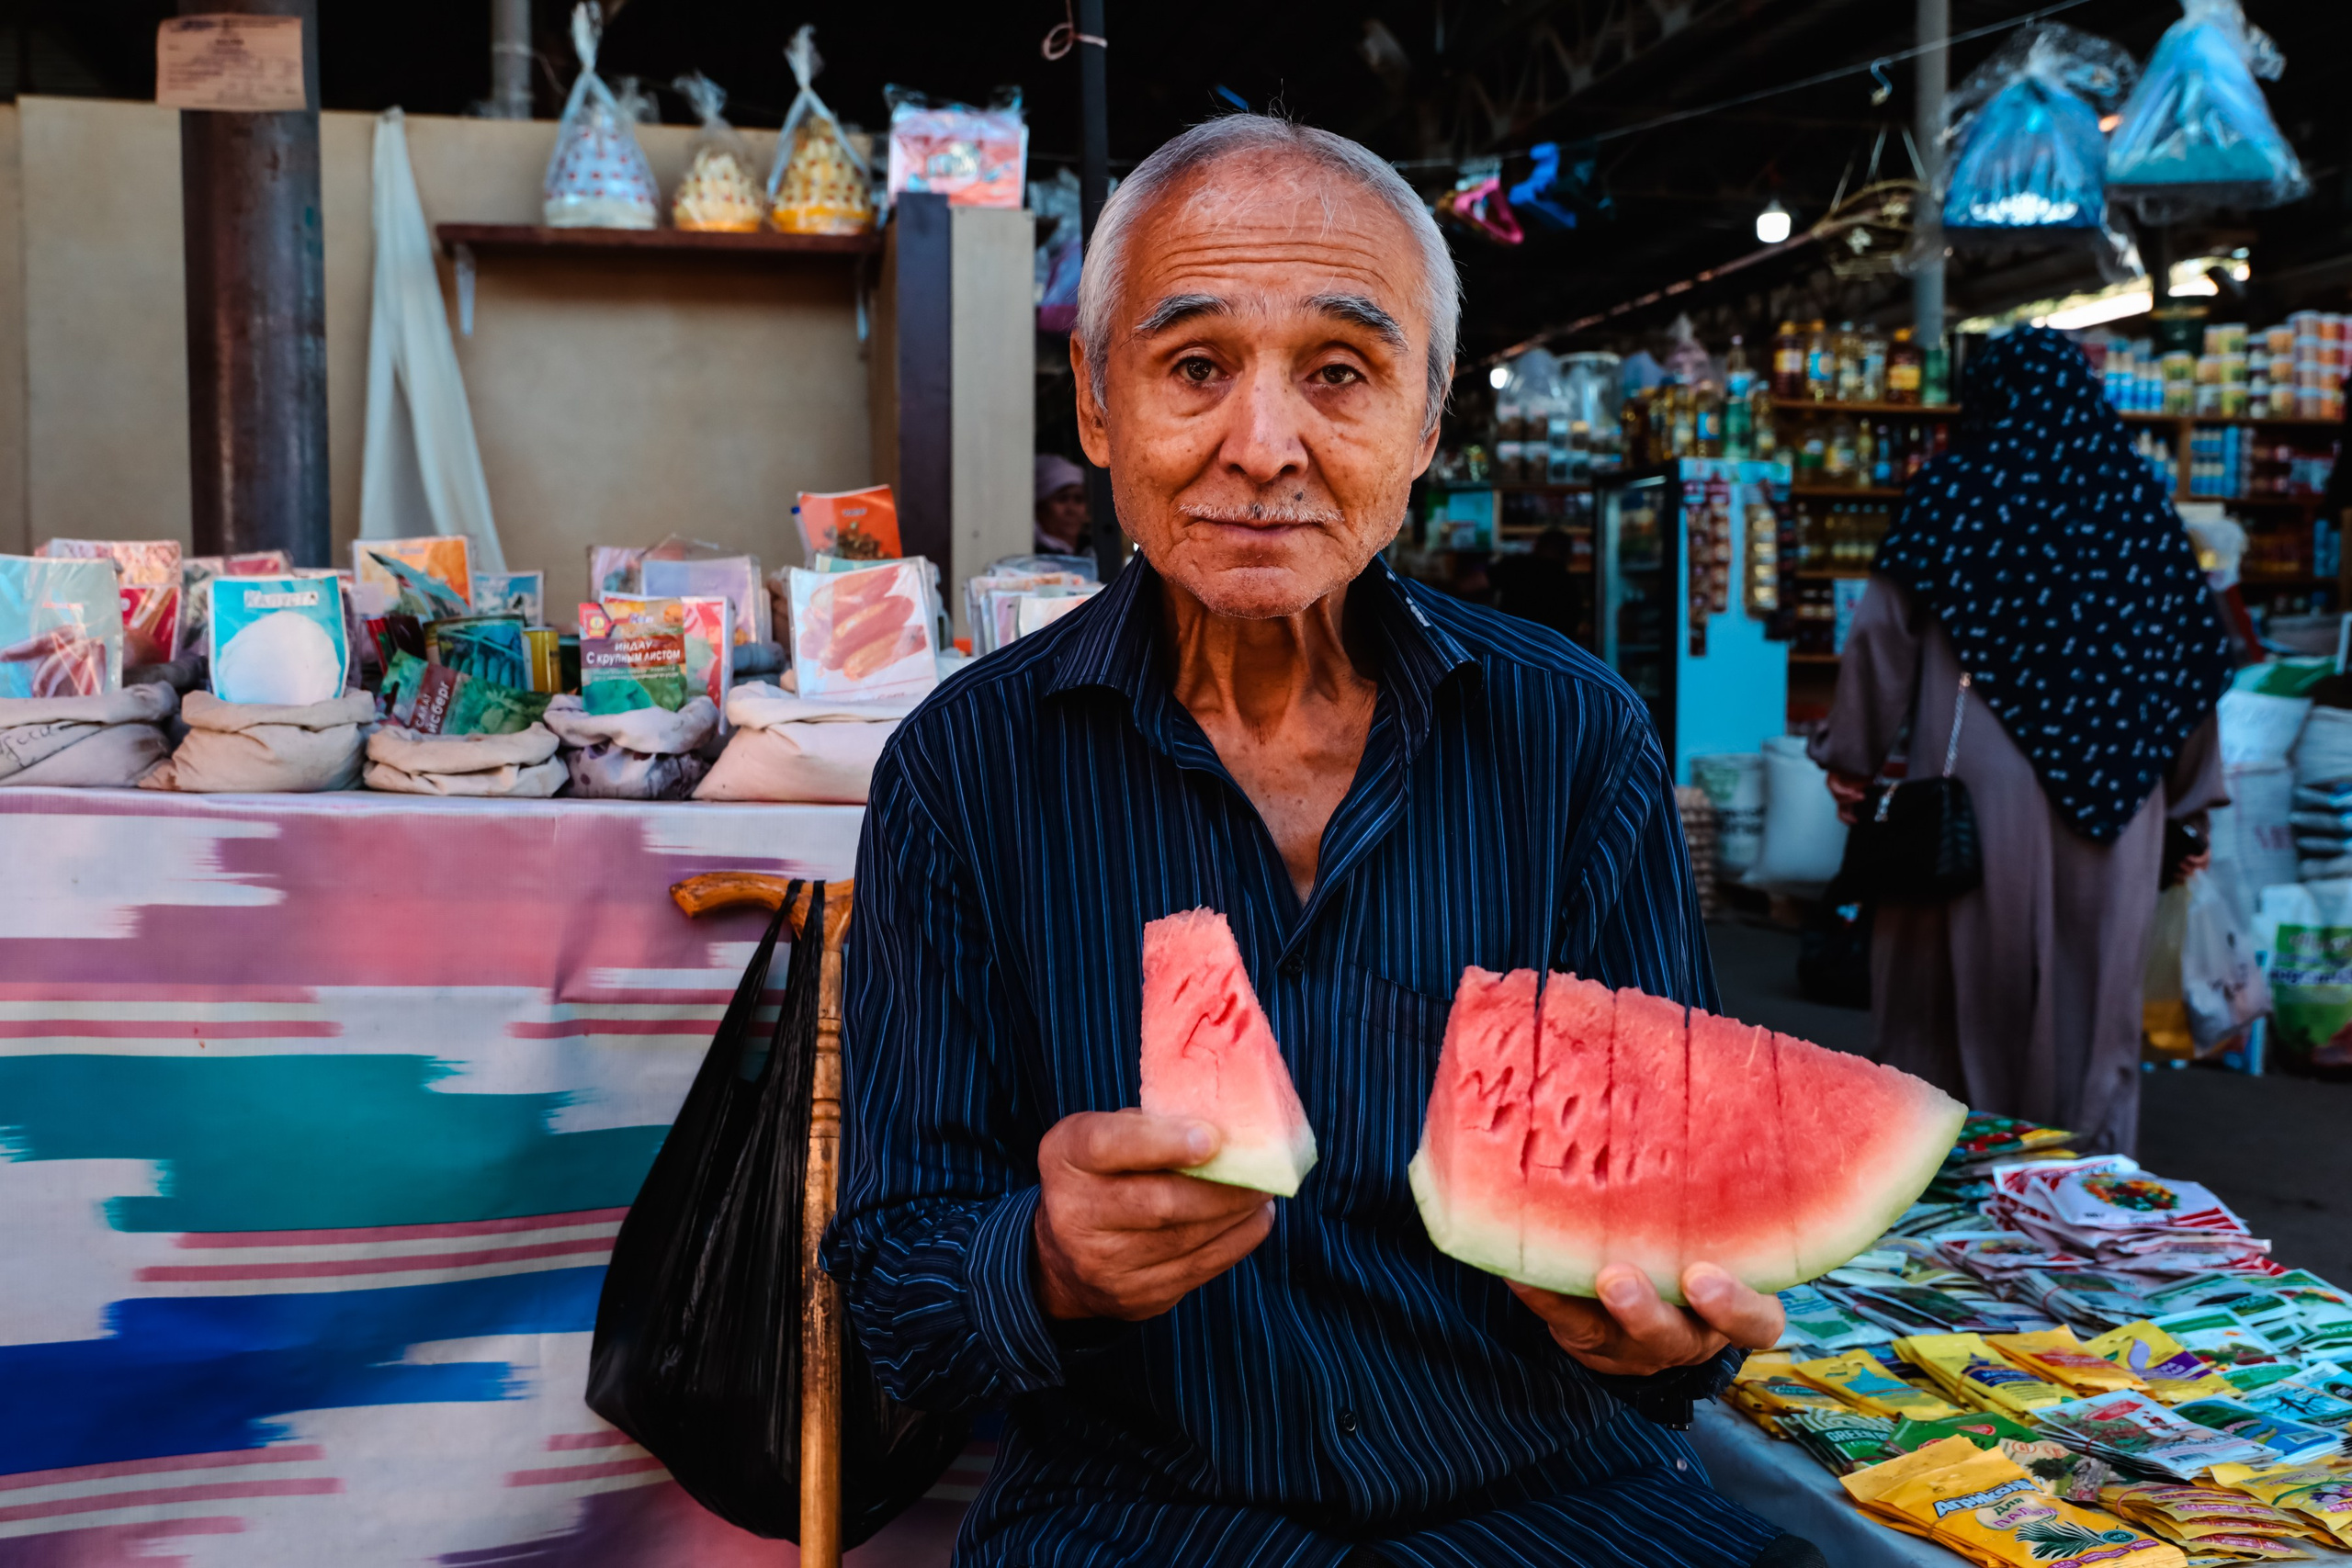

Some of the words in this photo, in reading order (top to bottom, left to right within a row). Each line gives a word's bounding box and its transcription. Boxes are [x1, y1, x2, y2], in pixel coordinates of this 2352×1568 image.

[615, 640, 653, 652] ИНДАУ
[596, 654, 642, 665] крупным
[644, 649, 681, 661] листом
[427, 681, 450, 734] йсберг
[1825, 1430, 1878, 1443] GREEN
